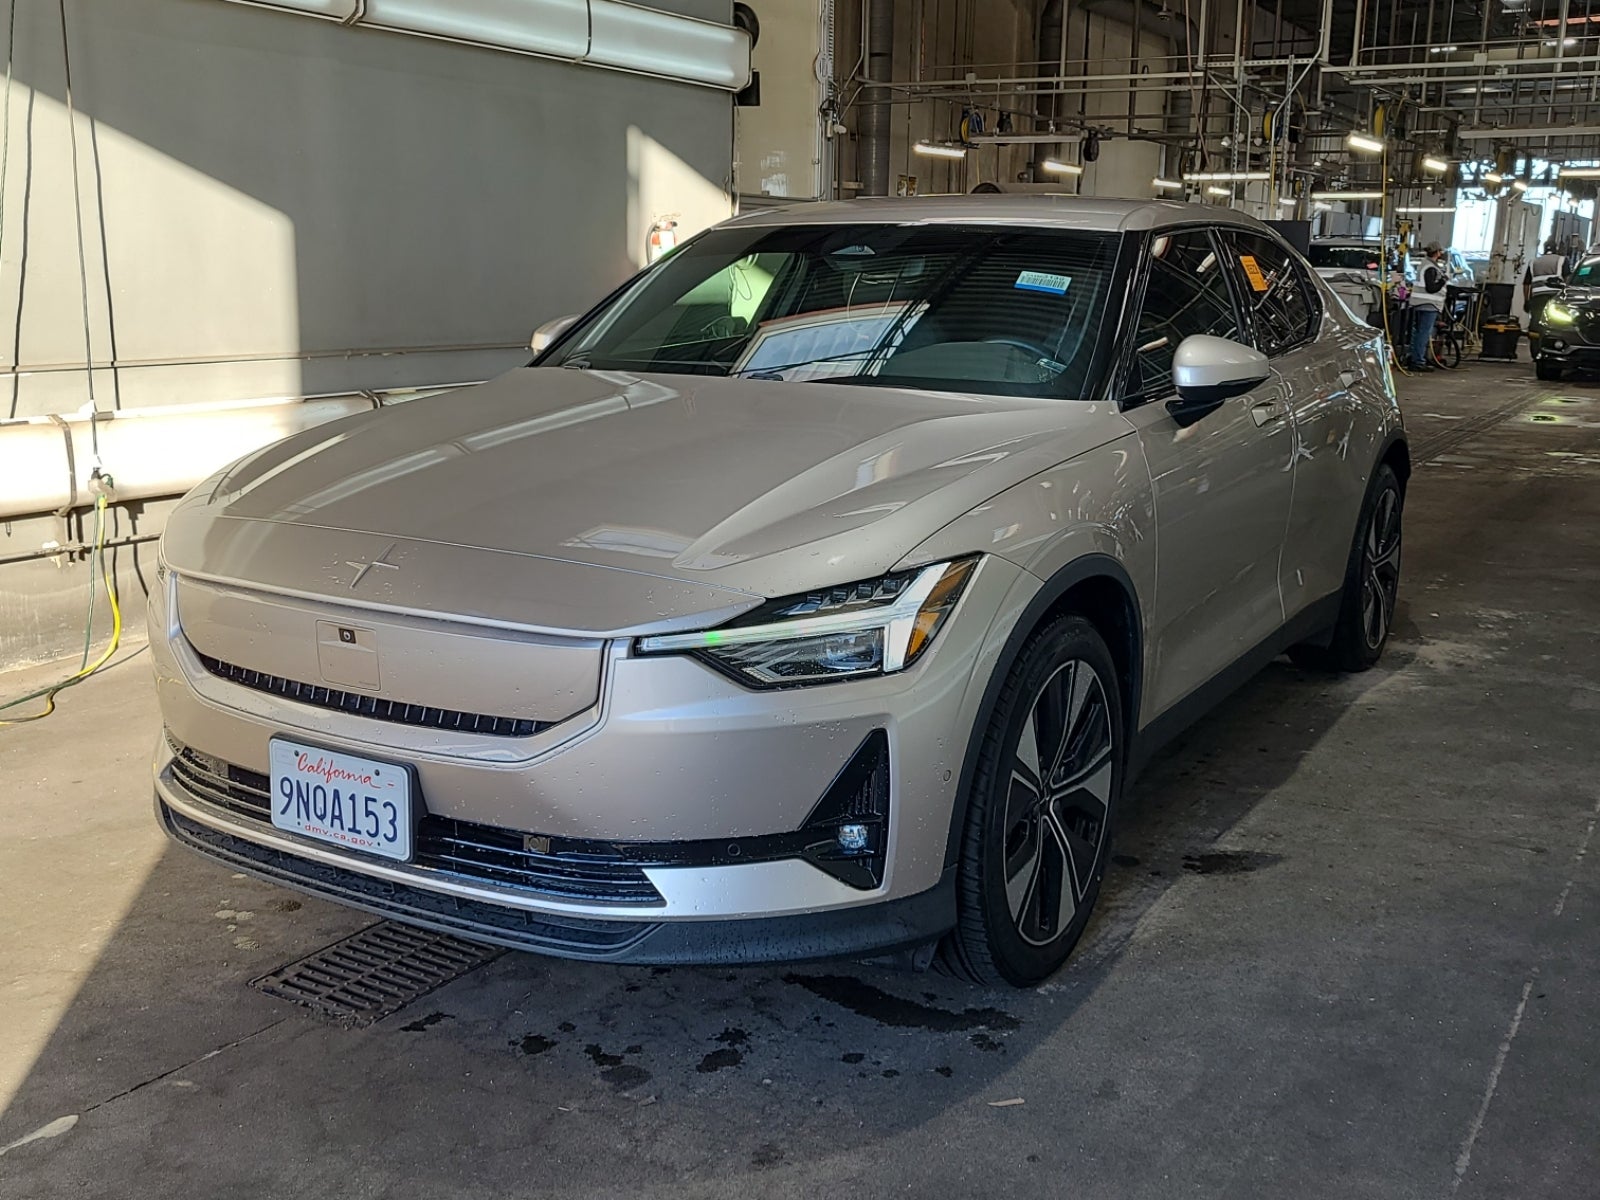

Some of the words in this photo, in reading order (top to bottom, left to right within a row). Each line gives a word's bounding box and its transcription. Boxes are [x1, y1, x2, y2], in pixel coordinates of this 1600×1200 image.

[296, 752, 382, 789] California
[279, 776, 398, 843] 9NQA153
[304, 823, 374, 848] dmv.ca.gov
